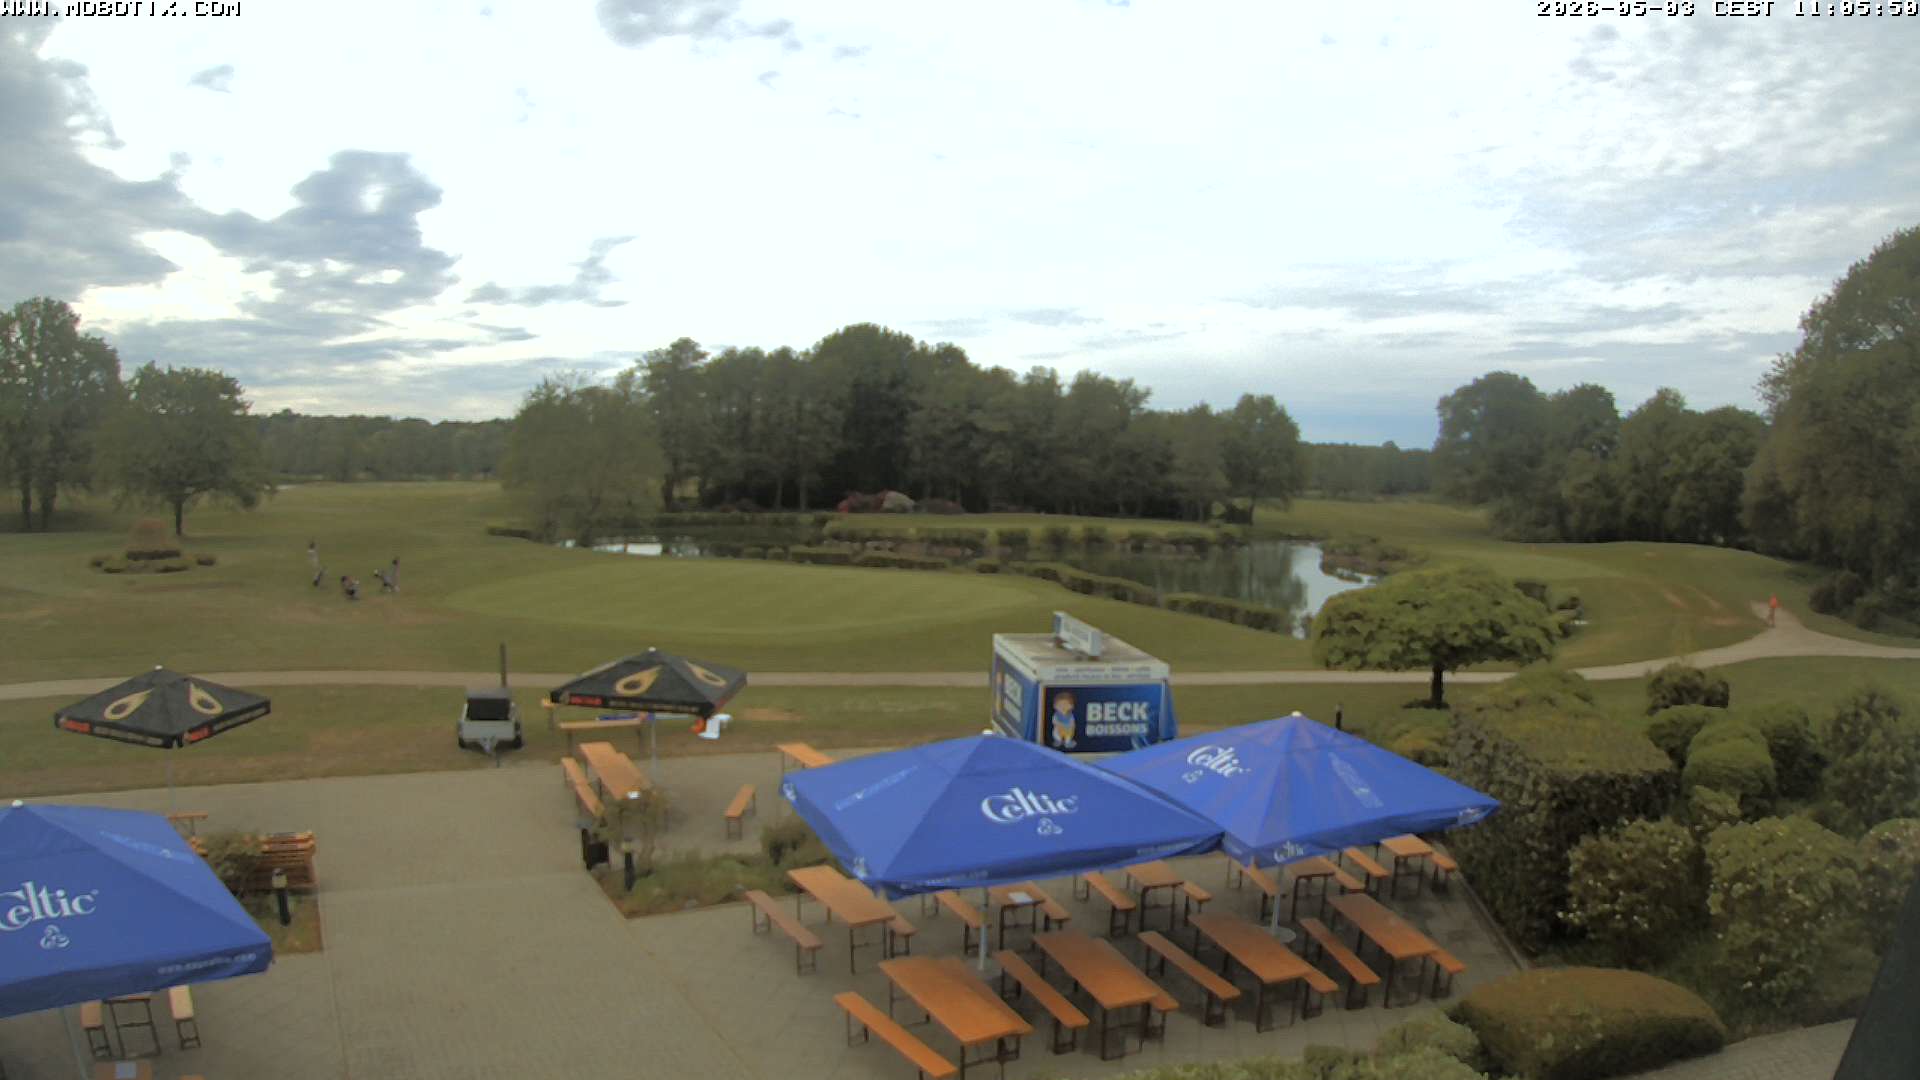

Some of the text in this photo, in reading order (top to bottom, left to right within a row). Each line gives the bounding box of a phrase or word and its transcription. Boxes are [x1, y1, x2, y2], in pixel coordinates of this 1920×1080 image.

[1086, 702, 1149, 721] BECK
[1085, 723, 1149, 737] BOISSONS
[981, 786, 1079, 823] Celtic
